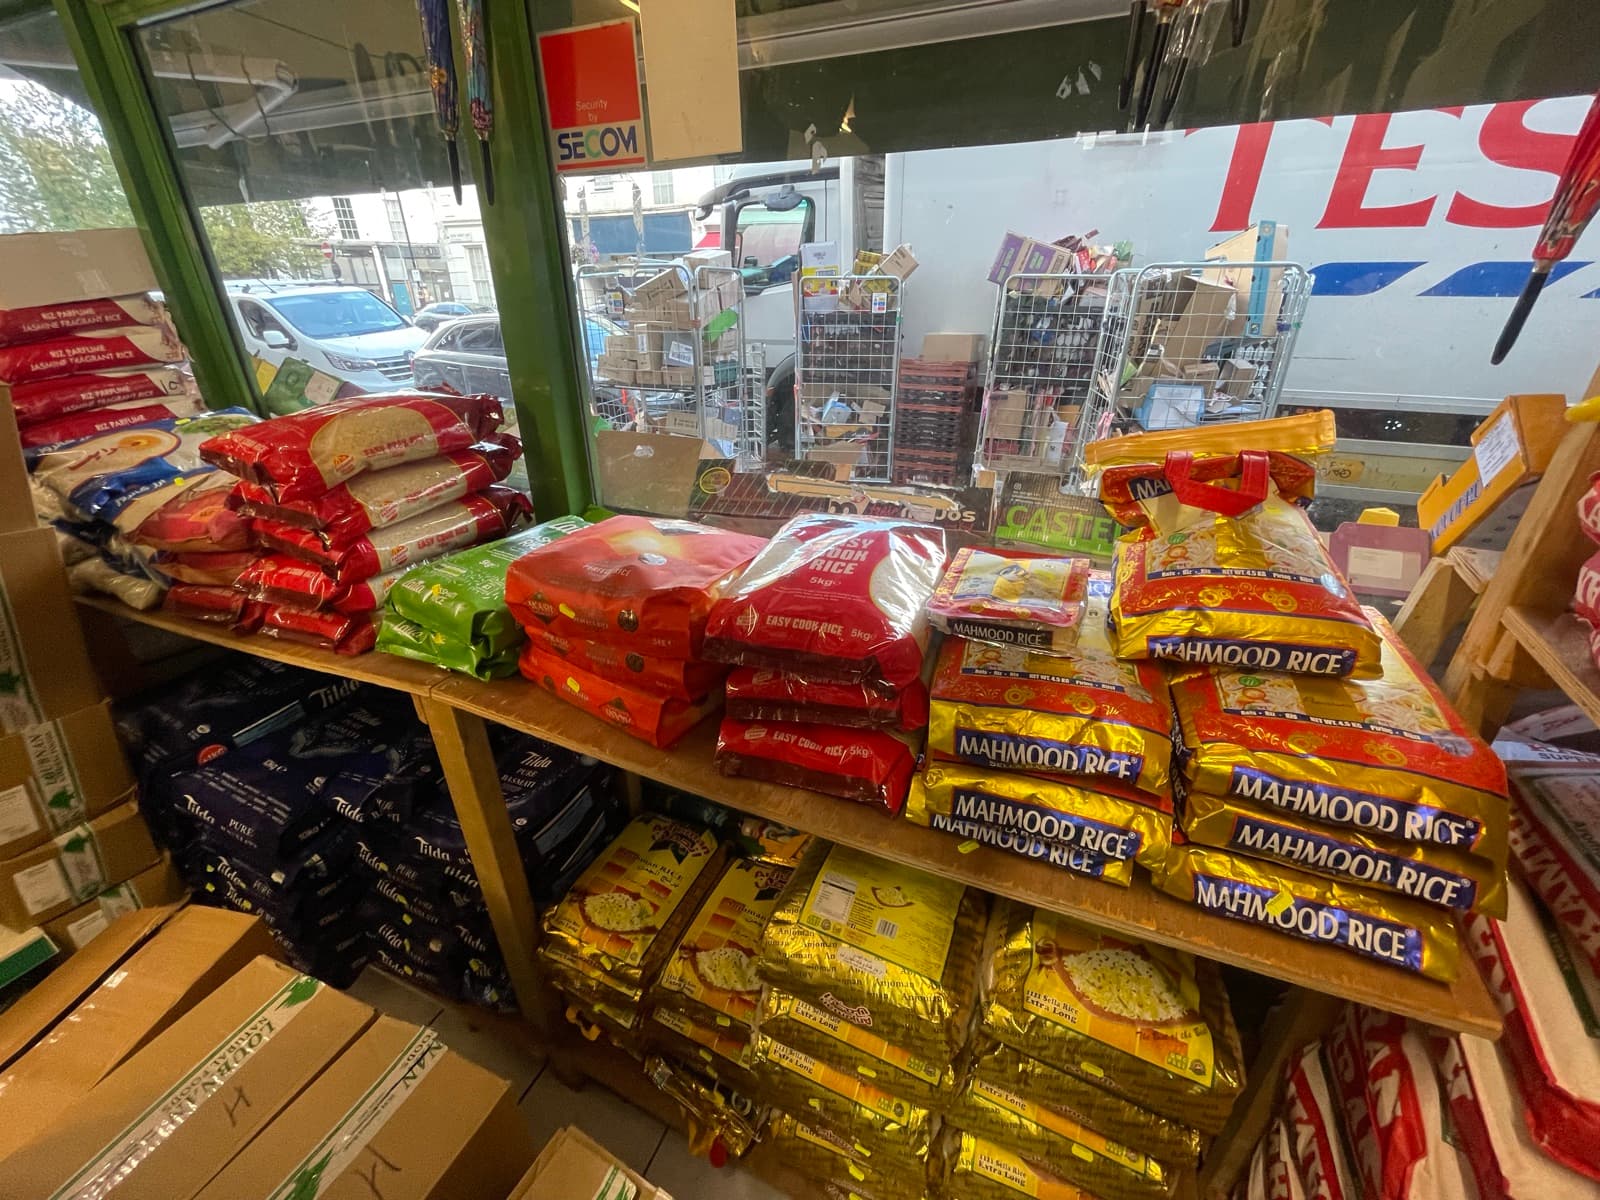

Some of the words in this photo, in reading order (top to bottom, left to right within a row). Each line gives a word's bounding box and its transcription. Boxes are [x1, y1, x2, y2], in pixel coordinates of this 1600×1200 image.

[575, 99, 608, 112] Security
[588, 112, 598, 122] by
[558, 125, 638, 160] SECOM
[809, 557, 858, 575] RICE
[809, 576, 833, 587] 5kg
[766, 615, 790, 627] EASY
[792, 618, 819, 632] COOK
[821, 622, 845, 637] RICE
[851, 629, 870, 642] 5kg
[953, 622, 1015, 642] MAHMOOD
[1017, 631, 1043, 647] RICE
[1153, 641, 1281, 669] MAHMOOD
[1286, 651, 1343, 676] RICE
[307, 680, 361, 709] Tilda
[520, 750, 553, 768] Tilda
[772, 732, 796, 746] EASY
[797, 737, 823, 753] COOK
[825, 744, 845, 757] RICE
[850, 746, 869, 759] 5kg
[959, 735, 1078, 771] MAHMOOD
[1084, 754, 1131, 780] RICE
[183, 793, 216, 825] Tilda
[331, 796, 365, 823] Tilda
[1235, 773, 1399, 834] MAHMOOD
[1404, 810, 1467, 845] RICE
[229, 818, 257, 837] PURE
[955, 795, 1077, 842] MAHMOOD
[1080, 825, 1128, 861] RICE
[356, 841, 383, 870] Tilda
[414, 836, 451, 862] Tilda
[933, 813, 1047, 859] MAHMOOD
[1050, 846, 1096, 874] RICE
[217, 855, 243, 886] Tilda
[1238, 824, 1393, 883] MAHMOOD
[1396, 866, 1462, 909] RICE
[778, 928, 816, 939] Anjoman
[1197, 880, 1340, 941] MAHMOOD
[1348, 918, 1406, 962] RICE
[795, 1006, 817, 1022] Extra
[819, 1018, 839, 1033] Long
[1026, 996, 1050, 1012] Extra
[1053, 1006, 1077, 1025] Long
[1062, 1003, 1079, 1015] Rice
[773, 1049, 795, 1064] Extra
[795, 1061, 814, 1075] Long
[979, 1080, 1003, 1097] Extra
[1005, 1093, 1027, 1111] Long
[978, 1161, 1003, 1176] Extra
[1005, 1172, 1027, 1187] Long
